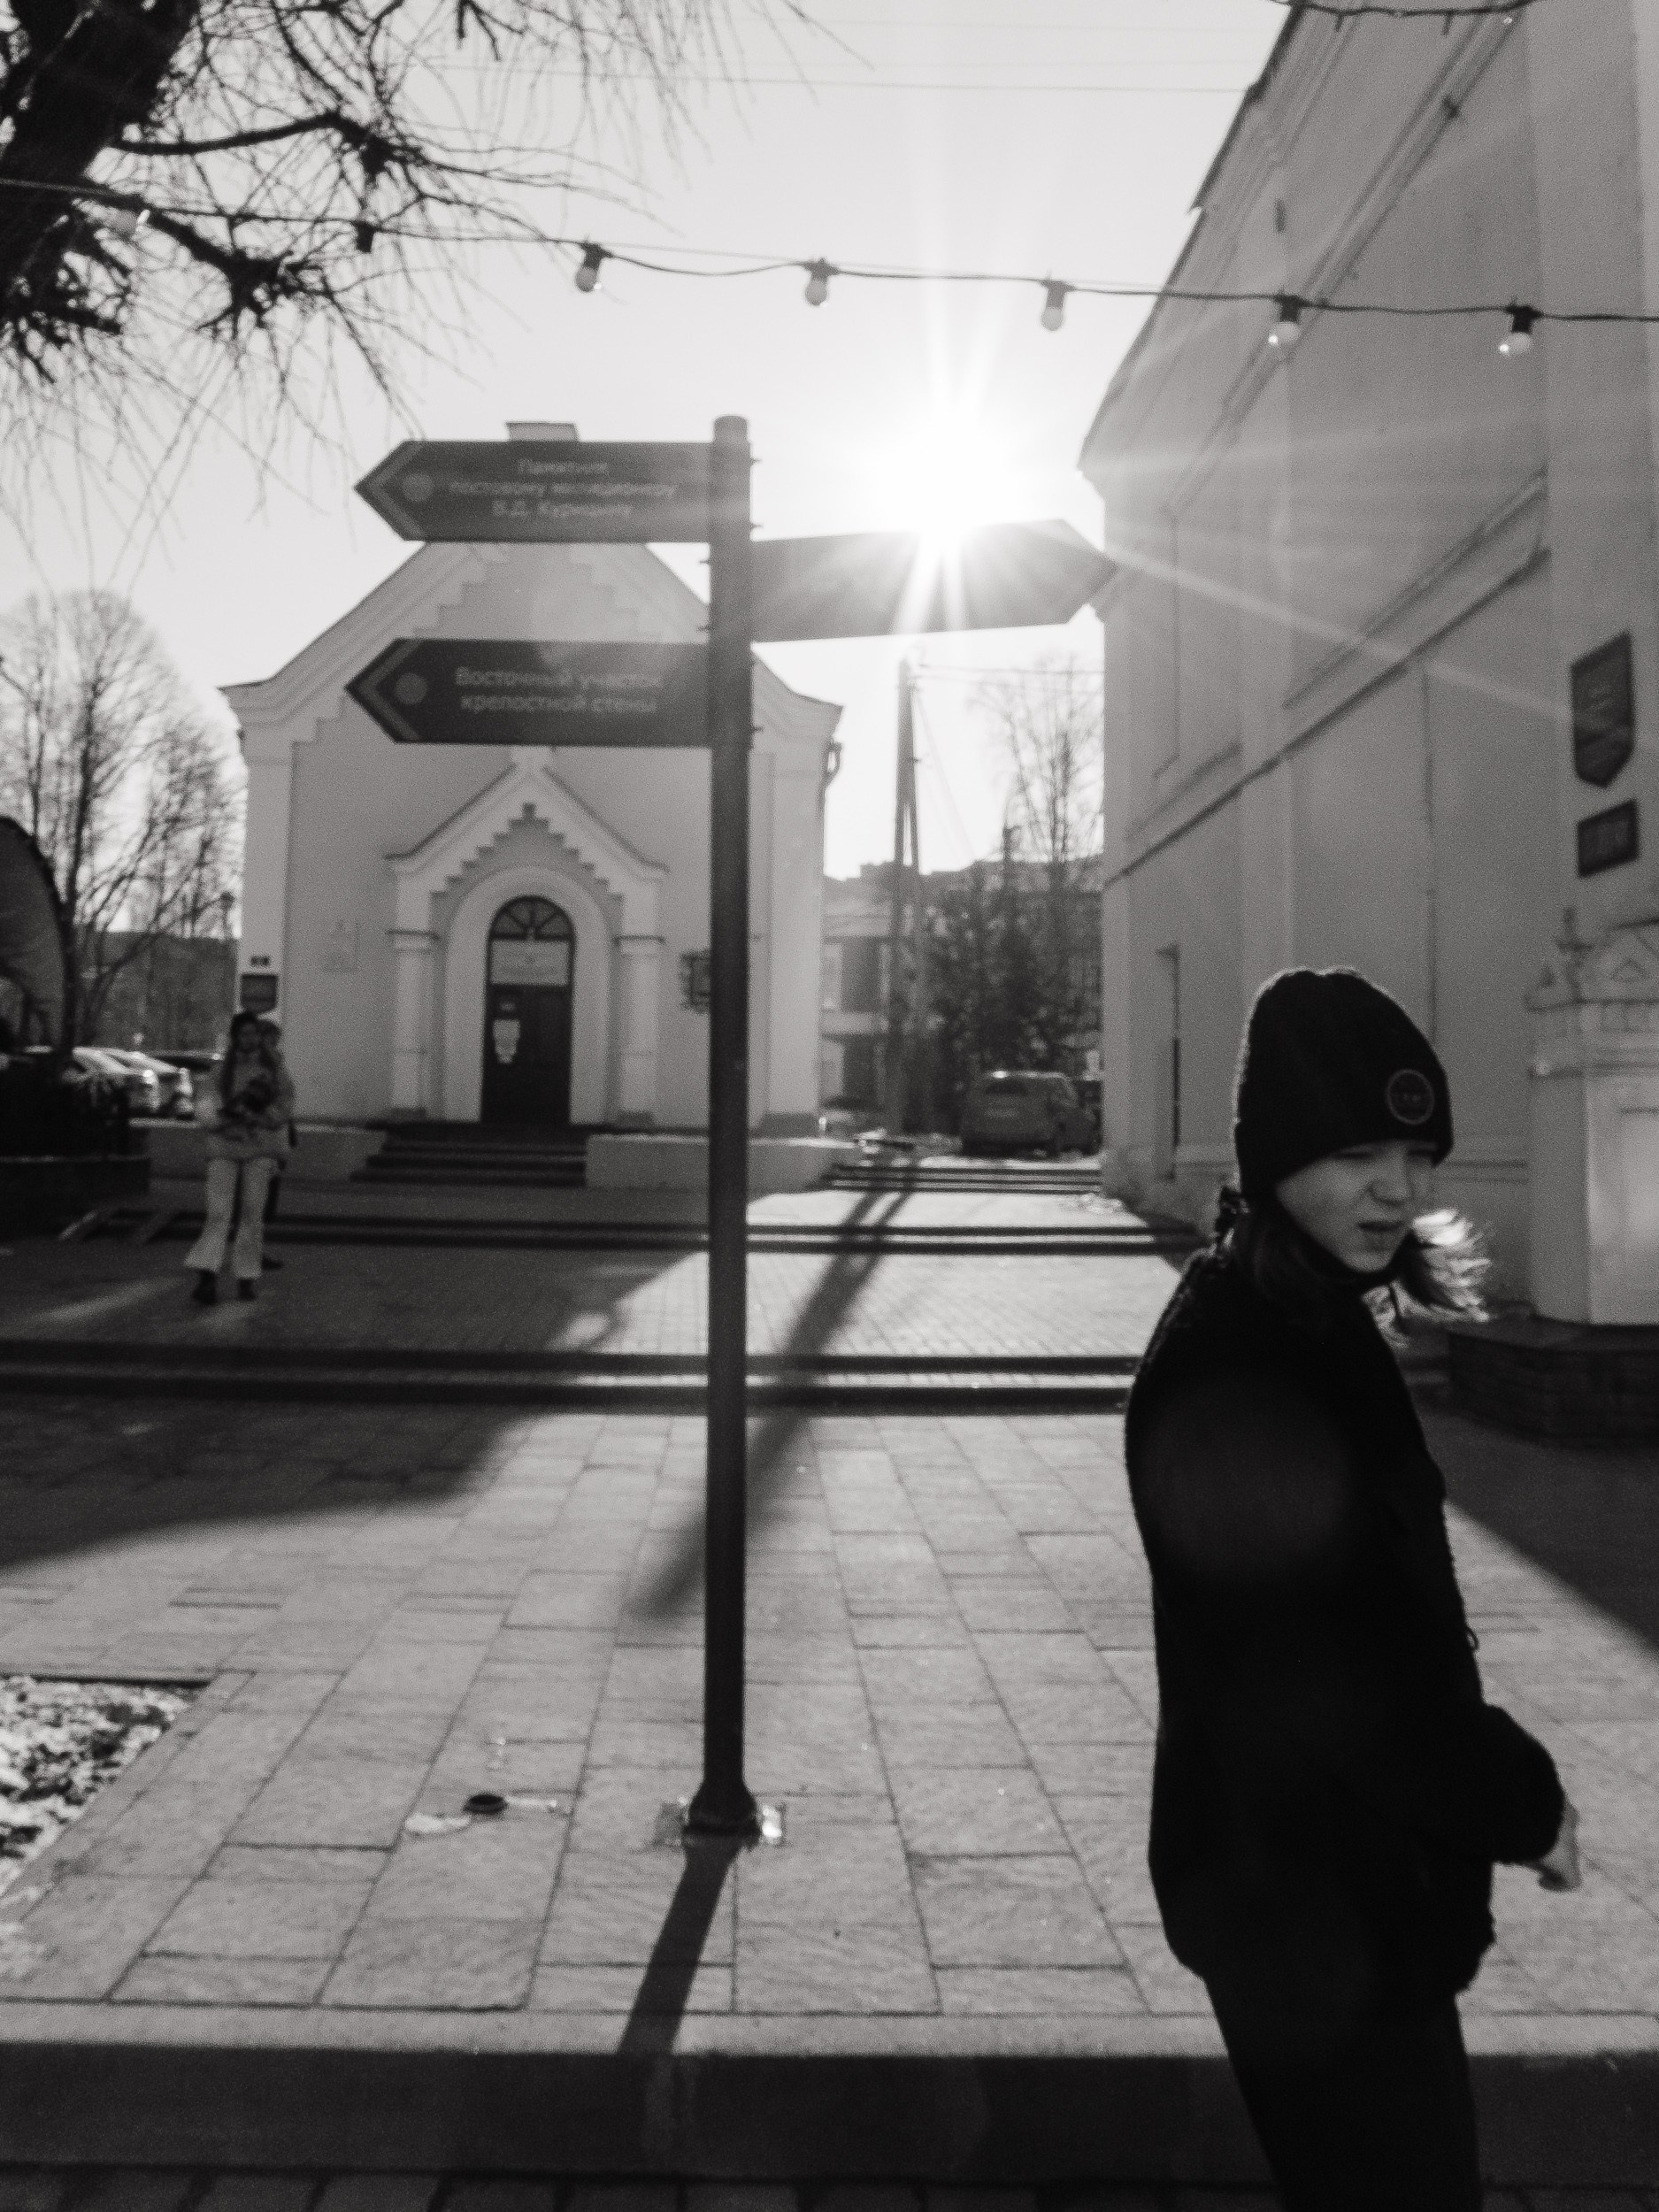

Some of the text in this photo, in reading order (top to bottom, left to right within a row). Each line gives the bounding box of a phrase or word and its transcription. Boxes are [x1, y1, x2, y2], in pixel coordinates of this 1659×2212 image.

[518, 458, 610, 474] Памятник
[455, 666, 664, 691] Восточный участок
[460, 695, 657, 713] крепостной стены
